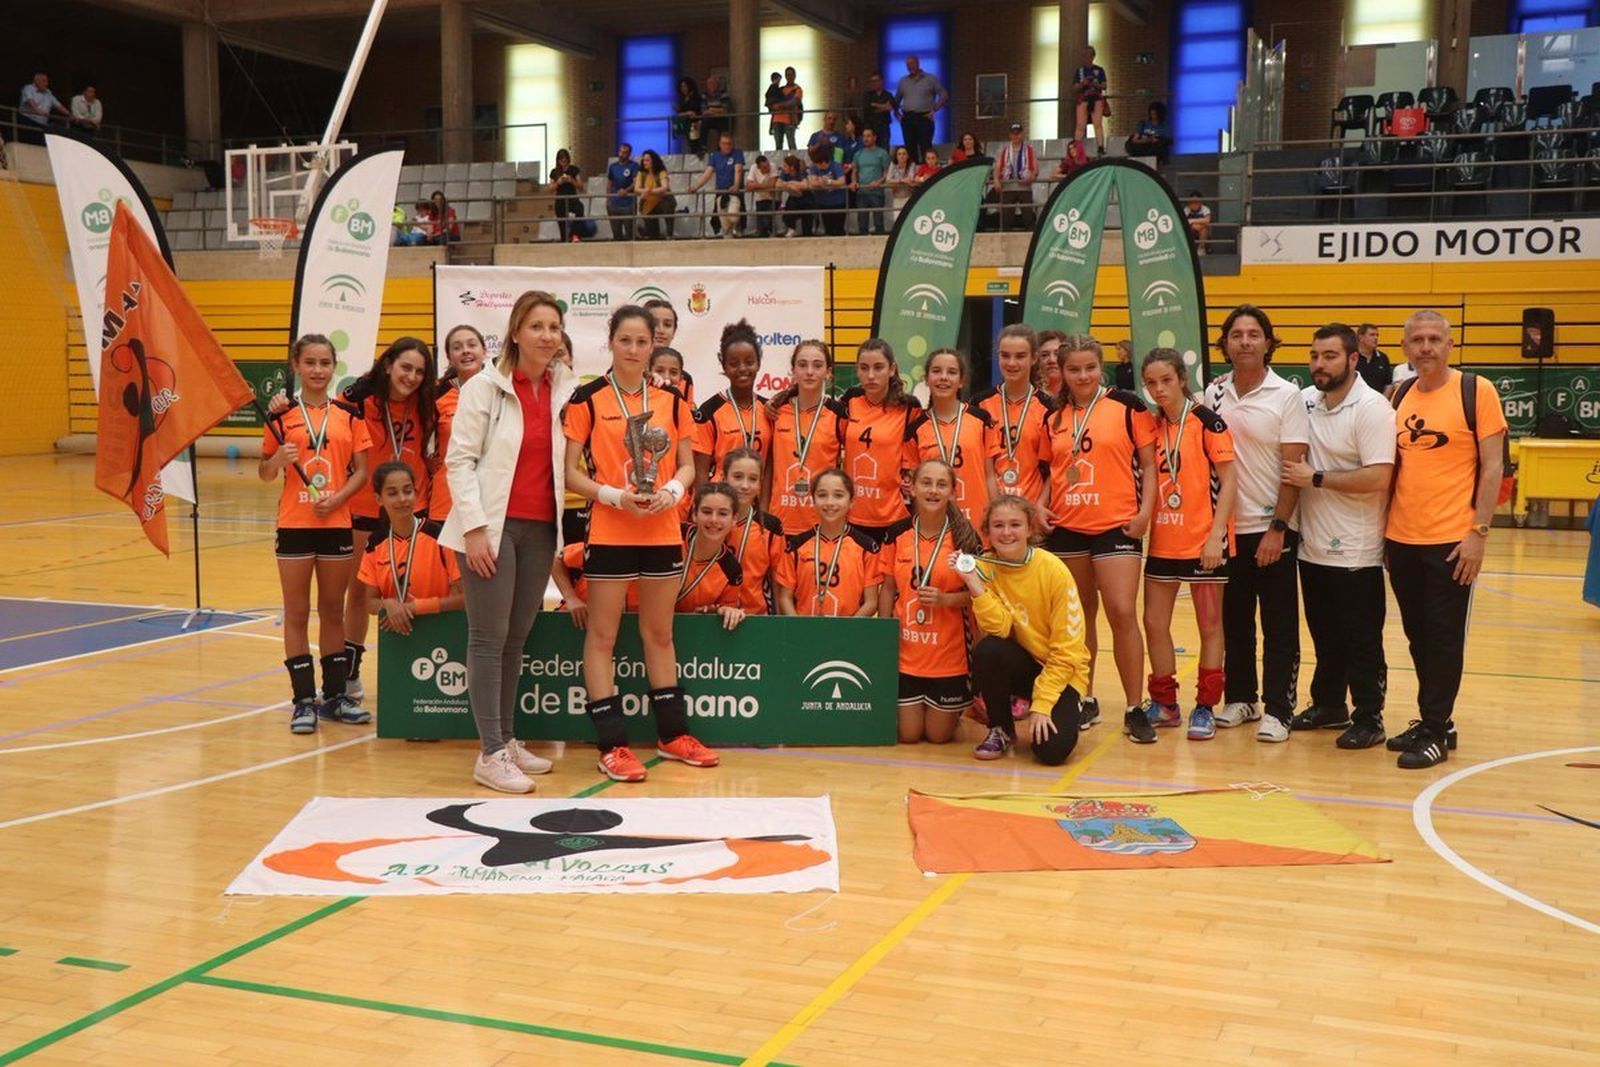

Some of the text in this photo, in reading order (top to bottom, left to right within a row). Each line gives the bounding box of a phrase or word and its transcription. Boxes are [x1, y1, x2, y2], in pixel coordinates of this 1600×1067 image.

[350, 218, 373, 235] BM
[1069, 228, 1089, 242] BM
[935, 229, 956, 246] BM
[1318, 227, 1582, 262] EJIDO MOTOR
[571, 292, 609, 305] FABM
[1500, 379, 1510, 390] A
[1505, 401, 1534, 417] BM
[1557, 393, 1567, 406] F
[1575, 379, 1586, 390] A
[859, 426, 872, 449] 4
[856, 485, 880, 499] BVI
[1065, 493, 1099, 506] BBVI
[902, 629, 938, 645] BBVI
[419, 650, 466, 687] F A BM
[520, 655, 645, 677] Federión
[520, 684, 560, 714] de
[801, 702, 822, 710] JUNTA
[825, 702, 833, 710] DE
[413, 705, 469, 713] de Balonmano
